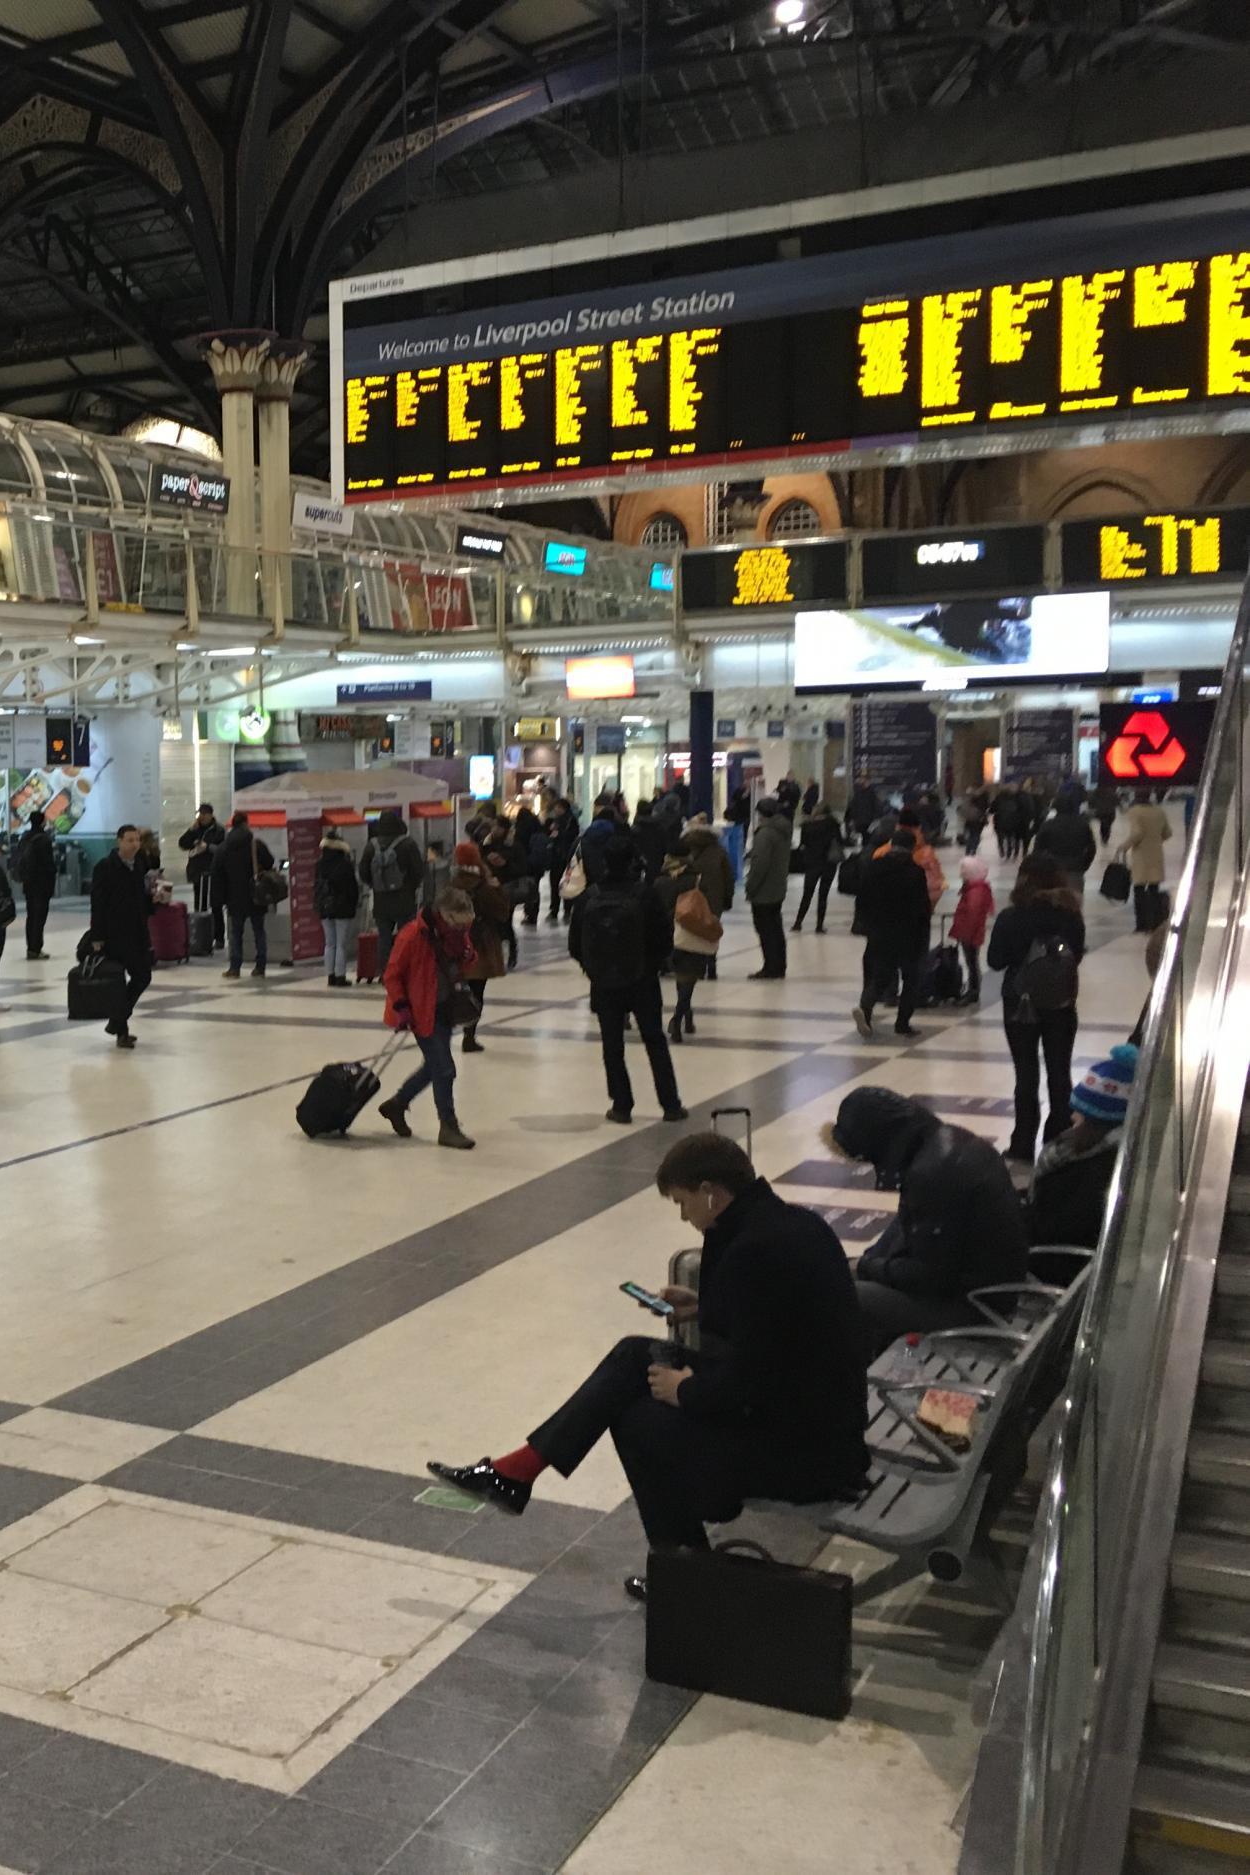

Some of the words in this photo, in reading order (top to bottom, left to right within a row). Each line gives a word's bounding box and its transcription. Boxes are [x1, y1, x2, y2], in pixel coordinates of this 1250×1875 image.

[350, 277, 405, 294] Departures
[378, 336, 449, 361] Welcome
[453, 333, 470, 350] to
[473, 310, 572, 347] Liverpool
[576, 302, 644, 333] Street
[650, 289, 735, 322] Station
[76, 723, 86, 746] 7
